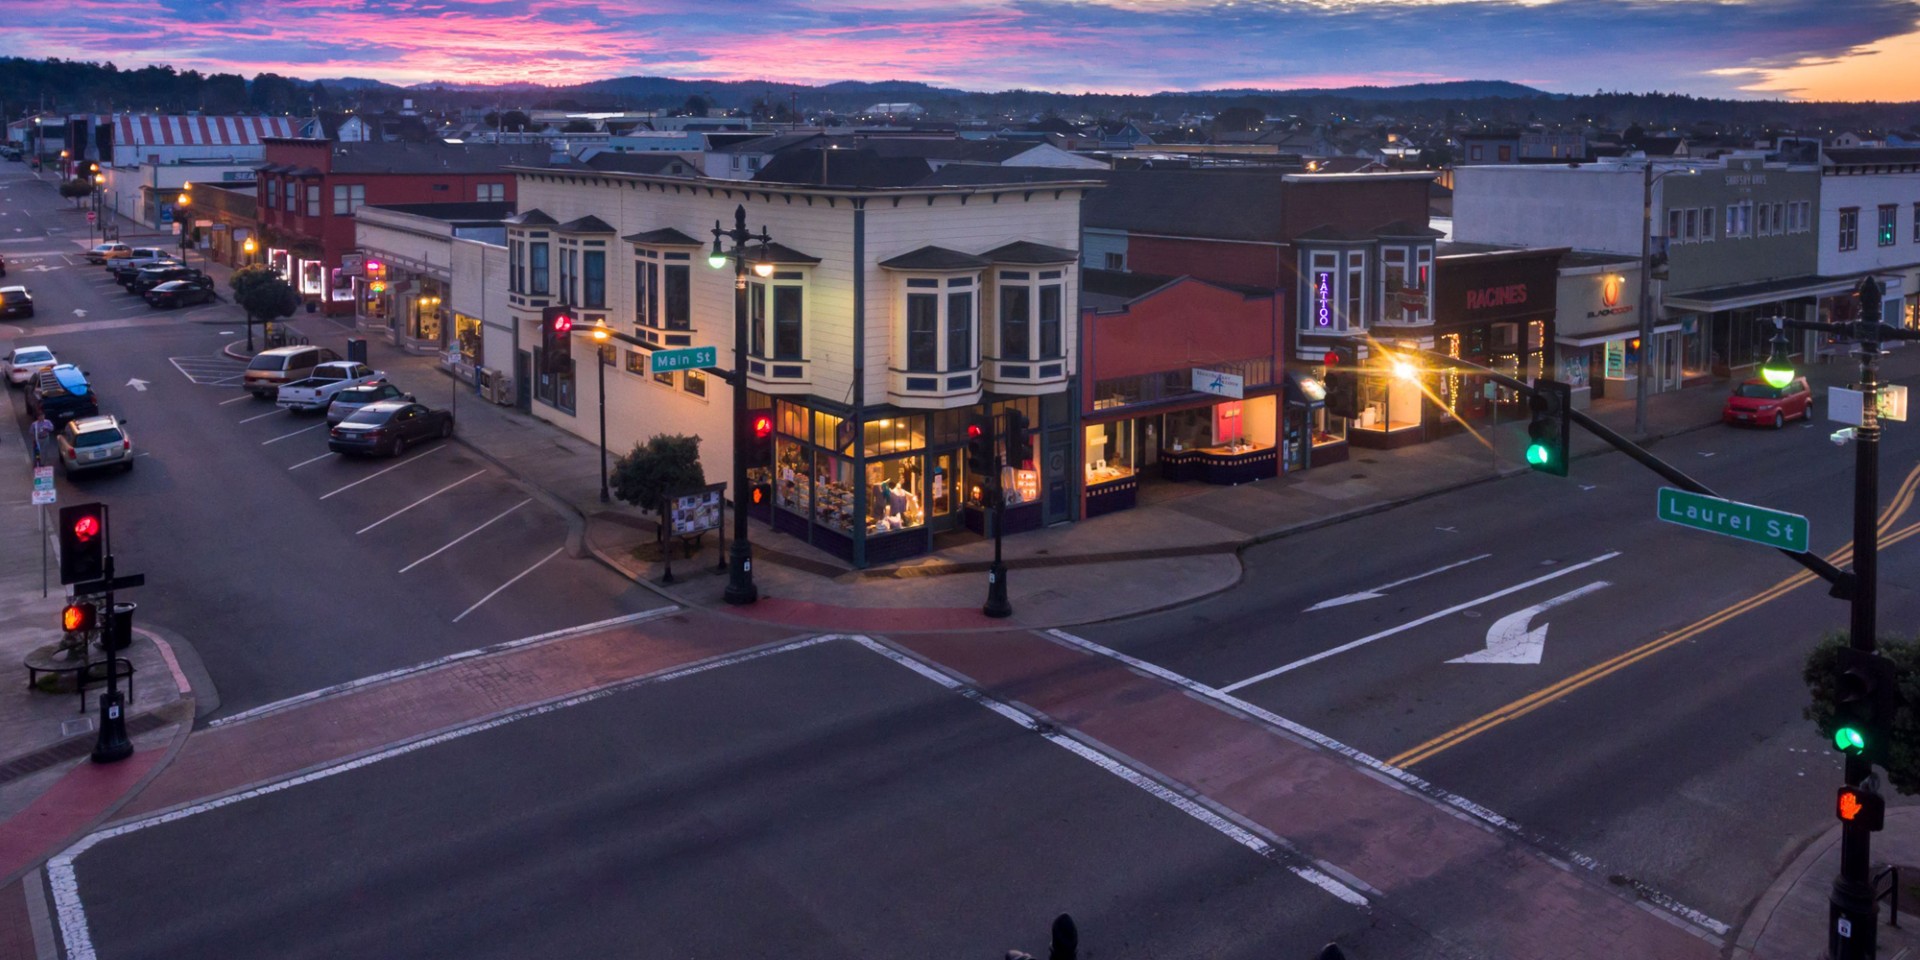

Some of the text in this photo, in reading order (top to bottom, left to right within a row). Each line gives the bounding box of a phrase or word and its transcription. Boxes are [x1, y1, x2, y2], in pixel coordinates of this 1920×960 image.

[1319, 273, 1328, 326] TATTOO
[1466, 284, 1527, 310] RACINES
[657, 352, 710, 367] Main St
[1670, 498, 1794, 541] Laurel St
